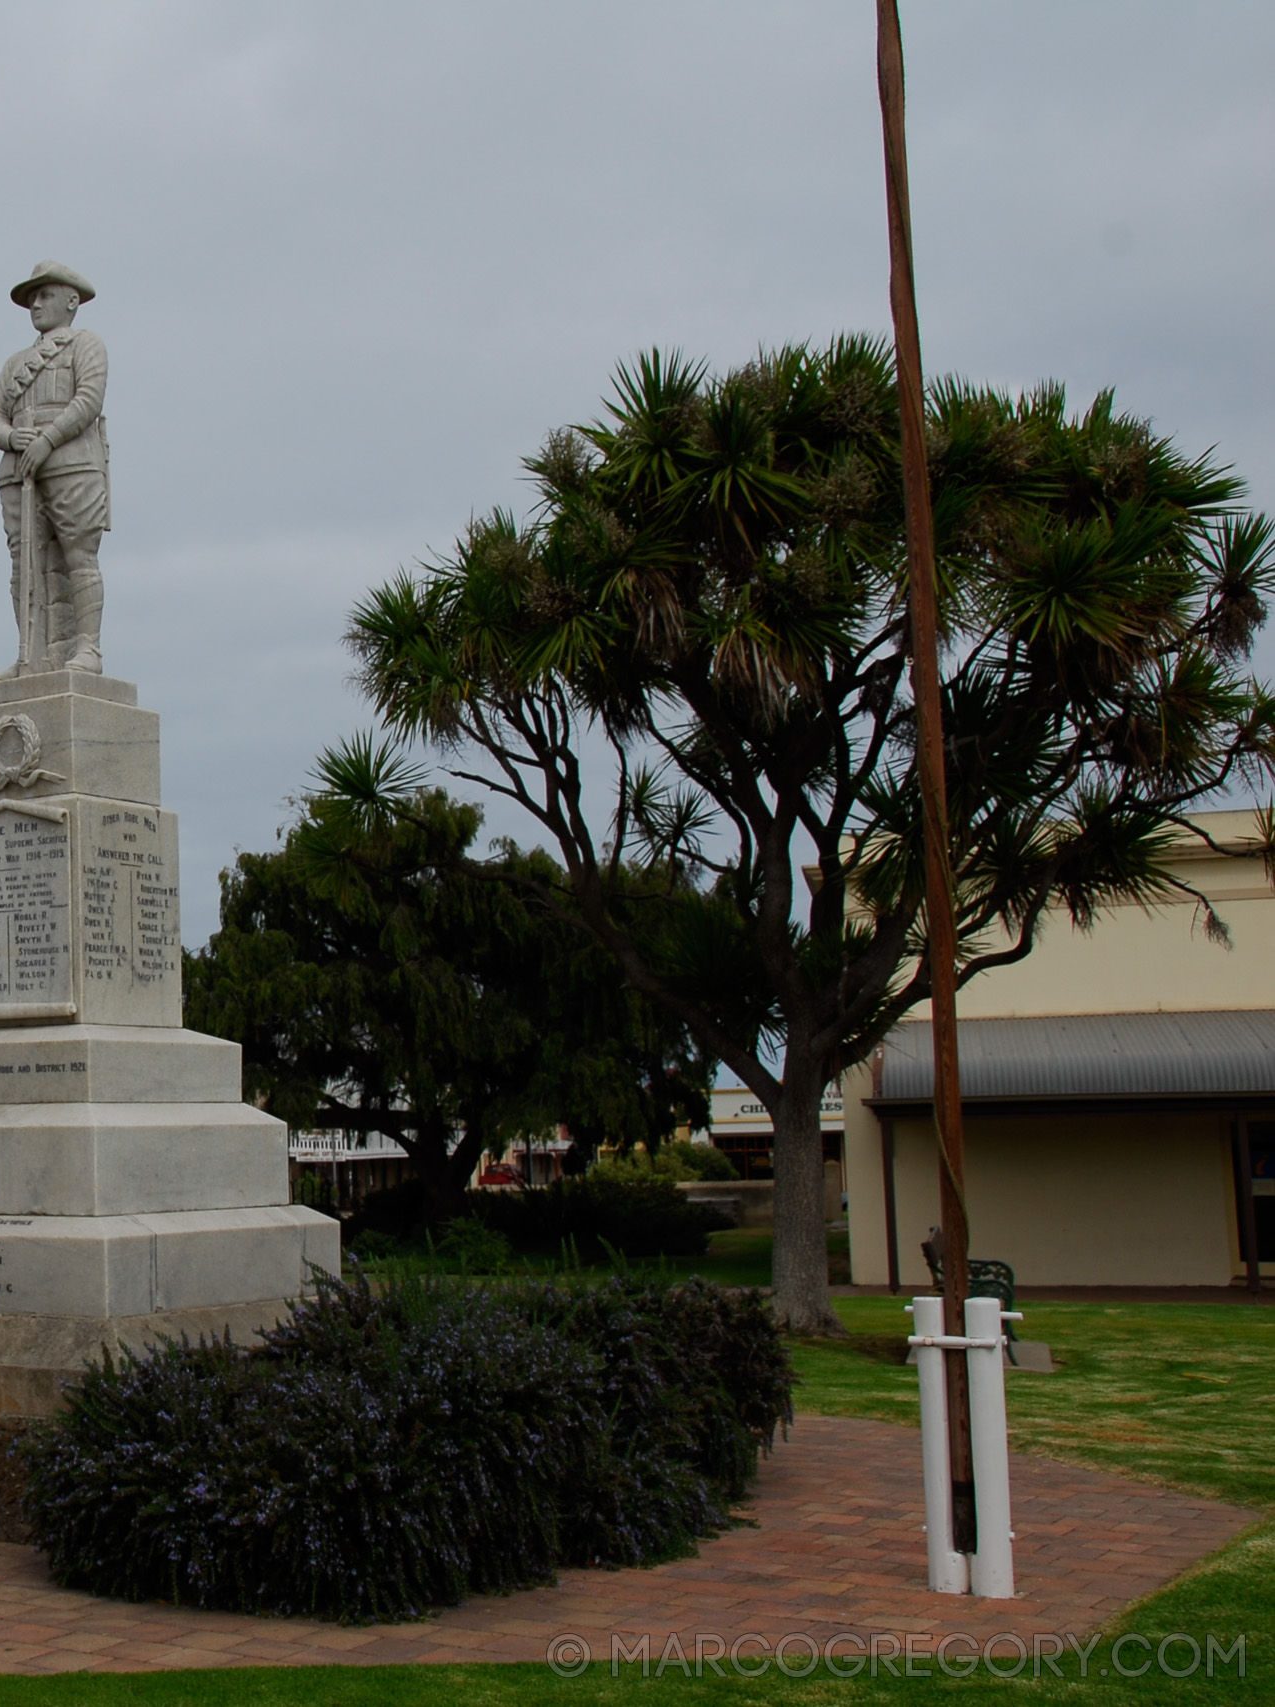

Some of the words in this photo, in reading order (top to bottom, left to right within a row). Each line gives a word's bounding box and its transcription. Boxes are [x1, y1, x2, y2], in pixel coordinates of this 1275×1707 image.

[103, 813, 119, 826] OTHER
[124, 811, 139, 824] ROBE
[144, 816, 156, 833] MEN
[14, 822, 37, 834] MEN
[4, 839, 33, 849] SUPREME
[37, 835, 68, 845] SACRIFICE
[123, 833, 137, 842] WHO
[5, 855, 20, 863] WAR
[98, 847, 129, 861] ANSWERED
[133, 853, 144, 863] THE
[136, 870, 152, 881] RYAN
[84, 892, 106, 902] MUTRIE
[88, 904, 104, 914] OWEN
[14, 913, 37, 922] NOBLE
[84, 917, 101, 927] OWEN
[18, 924, 46, 933] RIVETT
[15, 936, 41, 945] SMYTH
[19, 947, 59, 956] STONEHOUSE
[85, 942, 107, 953] PEARCE
[15, 959, 46, 968] SHEARER
[88, 956, 113, 966] PICKETT
[19, 970, 46, 979] WILSON
[15, 983, 34, 991] HOLT
[18, 1065, 31, 1073] AND
